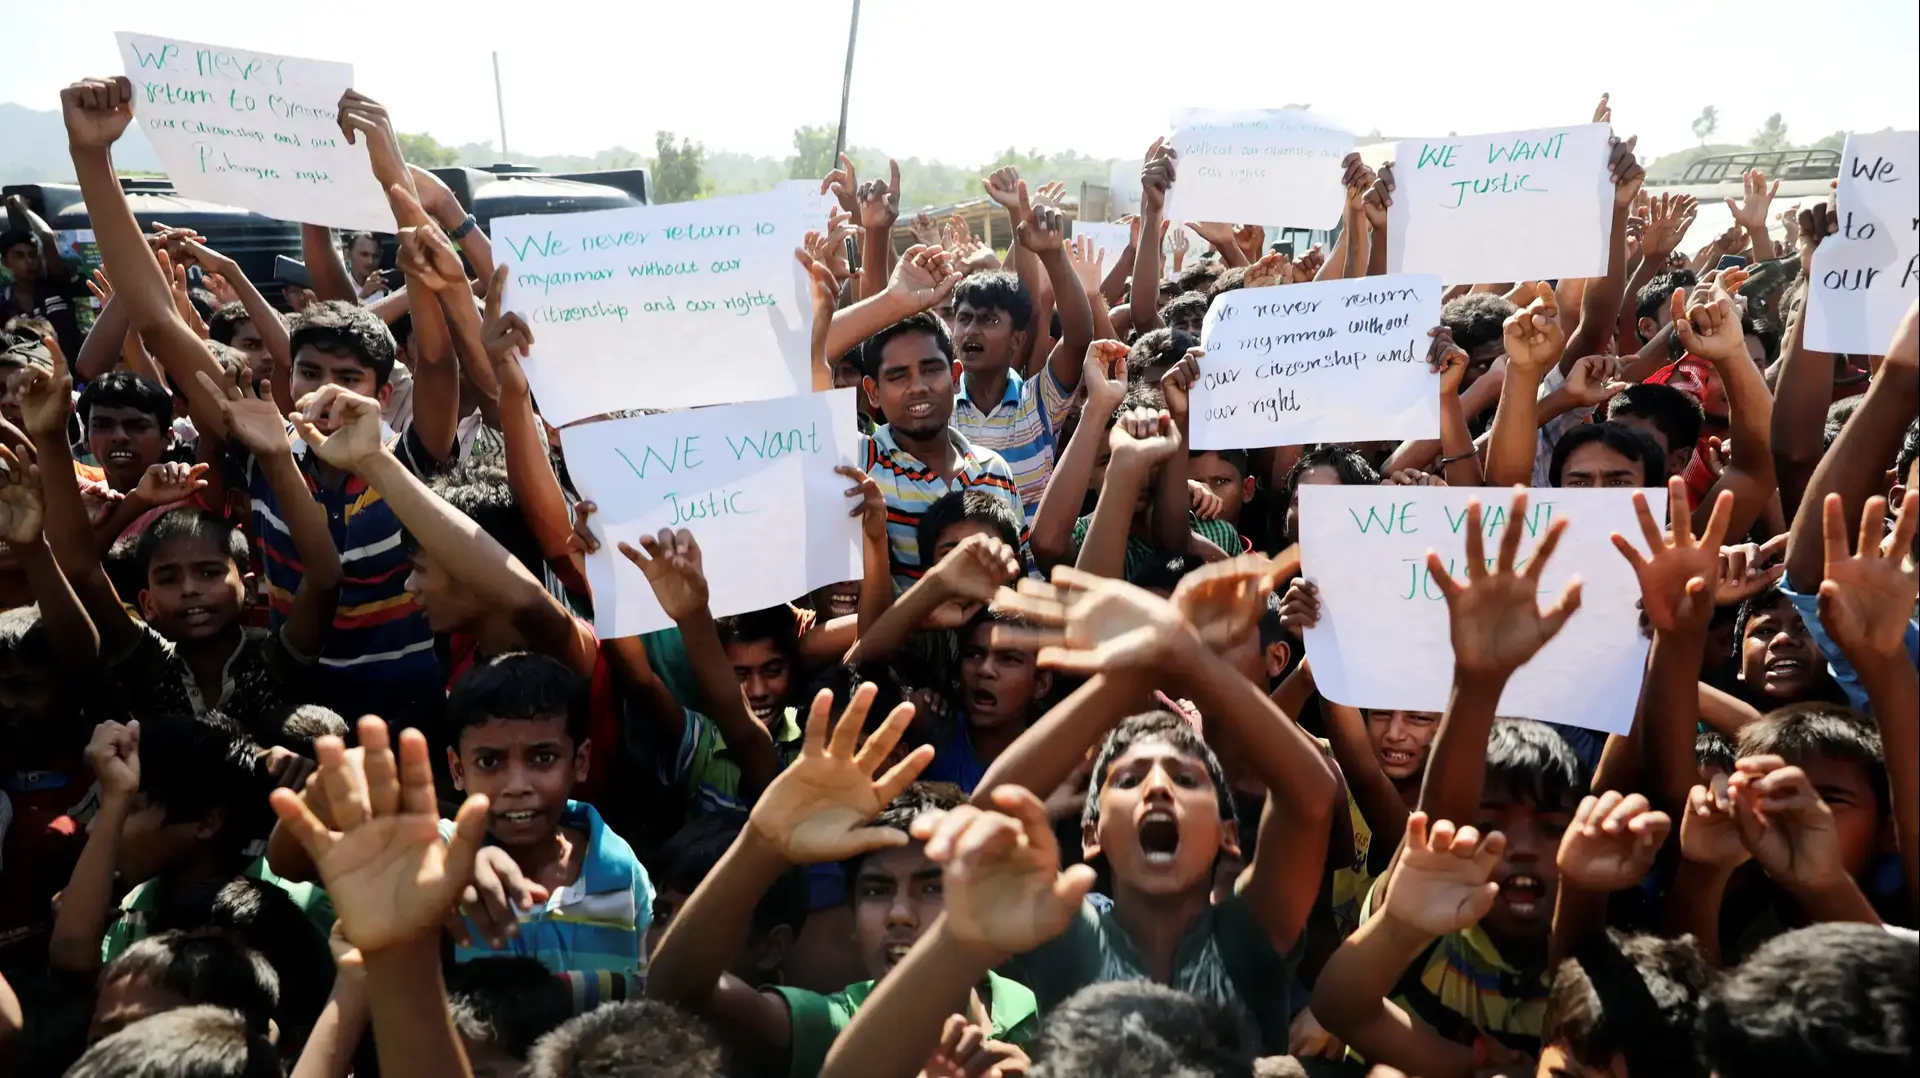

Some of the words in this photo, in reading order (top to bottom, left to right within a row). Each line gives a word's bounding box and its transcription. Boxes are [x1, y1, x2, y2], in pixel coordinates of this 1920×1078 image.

[268, 94, 338, 121] Myanma
[1417, 143, 1463, 169] WE
[1488, 133, 1570, 164] WANT
[504, 230, 570, 262] We
[582, 231, 650, 251] never
[662, 223, 740, 240] return
[752, 222, 776, 236] to
[1843, 211, 1876, 240] to
[517, 268, 614, 296] myanmar
[627, 260, 699, 278] without
[710, 257, 742, 274] our
[1823, 267, 1882, 291] our
[532, 300, 629, 323] citizenship
[643, 296, 676, 313] and
[685, 299, 716, 311] our
[722, 290, 777, 316] rights
[1204, 367, 1243, 391] our
[1376, 338, 1426, 363] and
[614, 435, 704, 480] WE
[1348, 501, 1419, 535] WE
